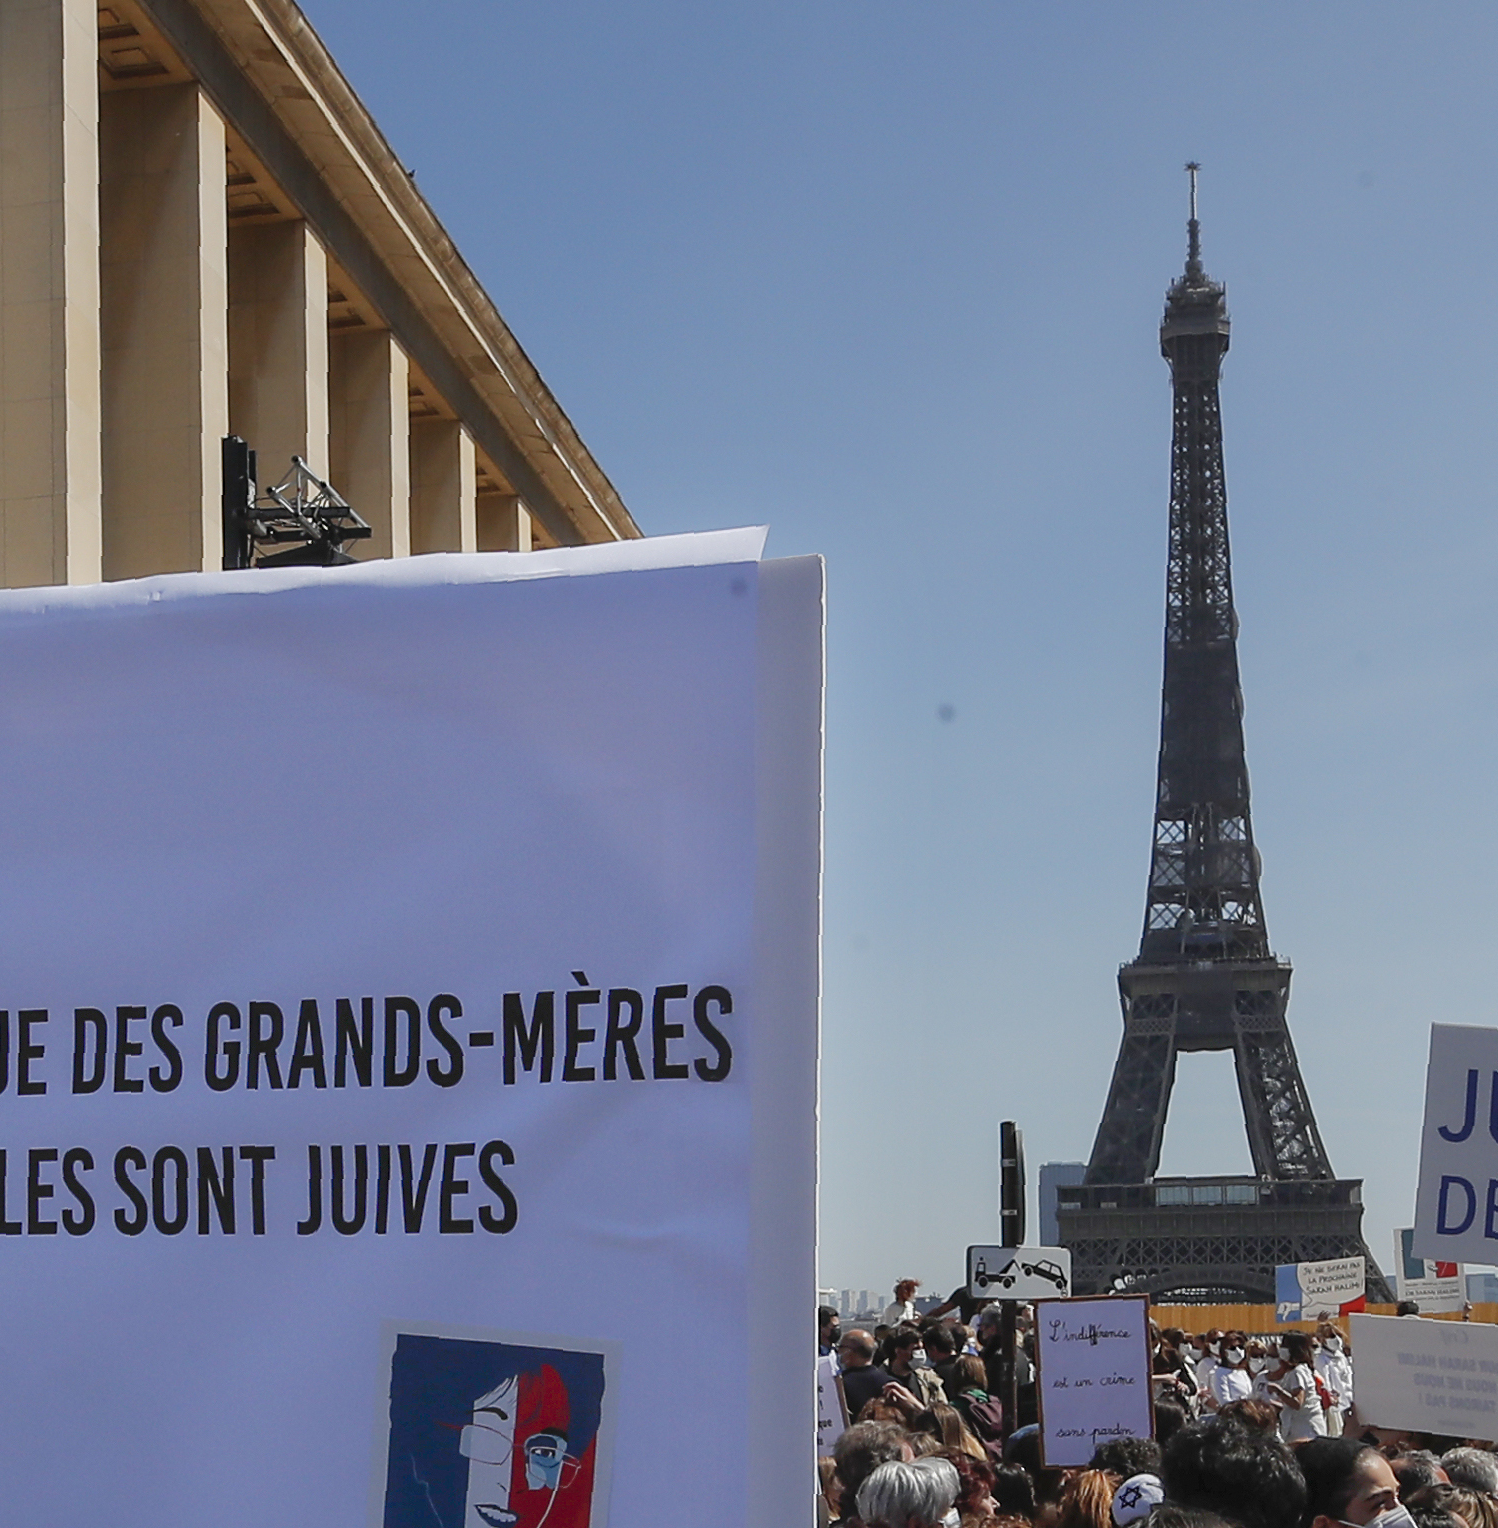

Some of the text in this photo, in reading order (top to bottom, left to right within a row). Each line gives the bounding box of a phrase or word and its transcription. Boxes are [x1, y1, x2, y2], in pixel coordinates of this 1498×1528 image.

[71, 1003, 184, 1095] DES
[204, 971, 733, 1093] GRANDS-MÈRES
[113, 1145, 276, 1237] SONT
[296, 1140, 518, 1236] JUIVES
[1099, 1372, 1135, 1387] crime
